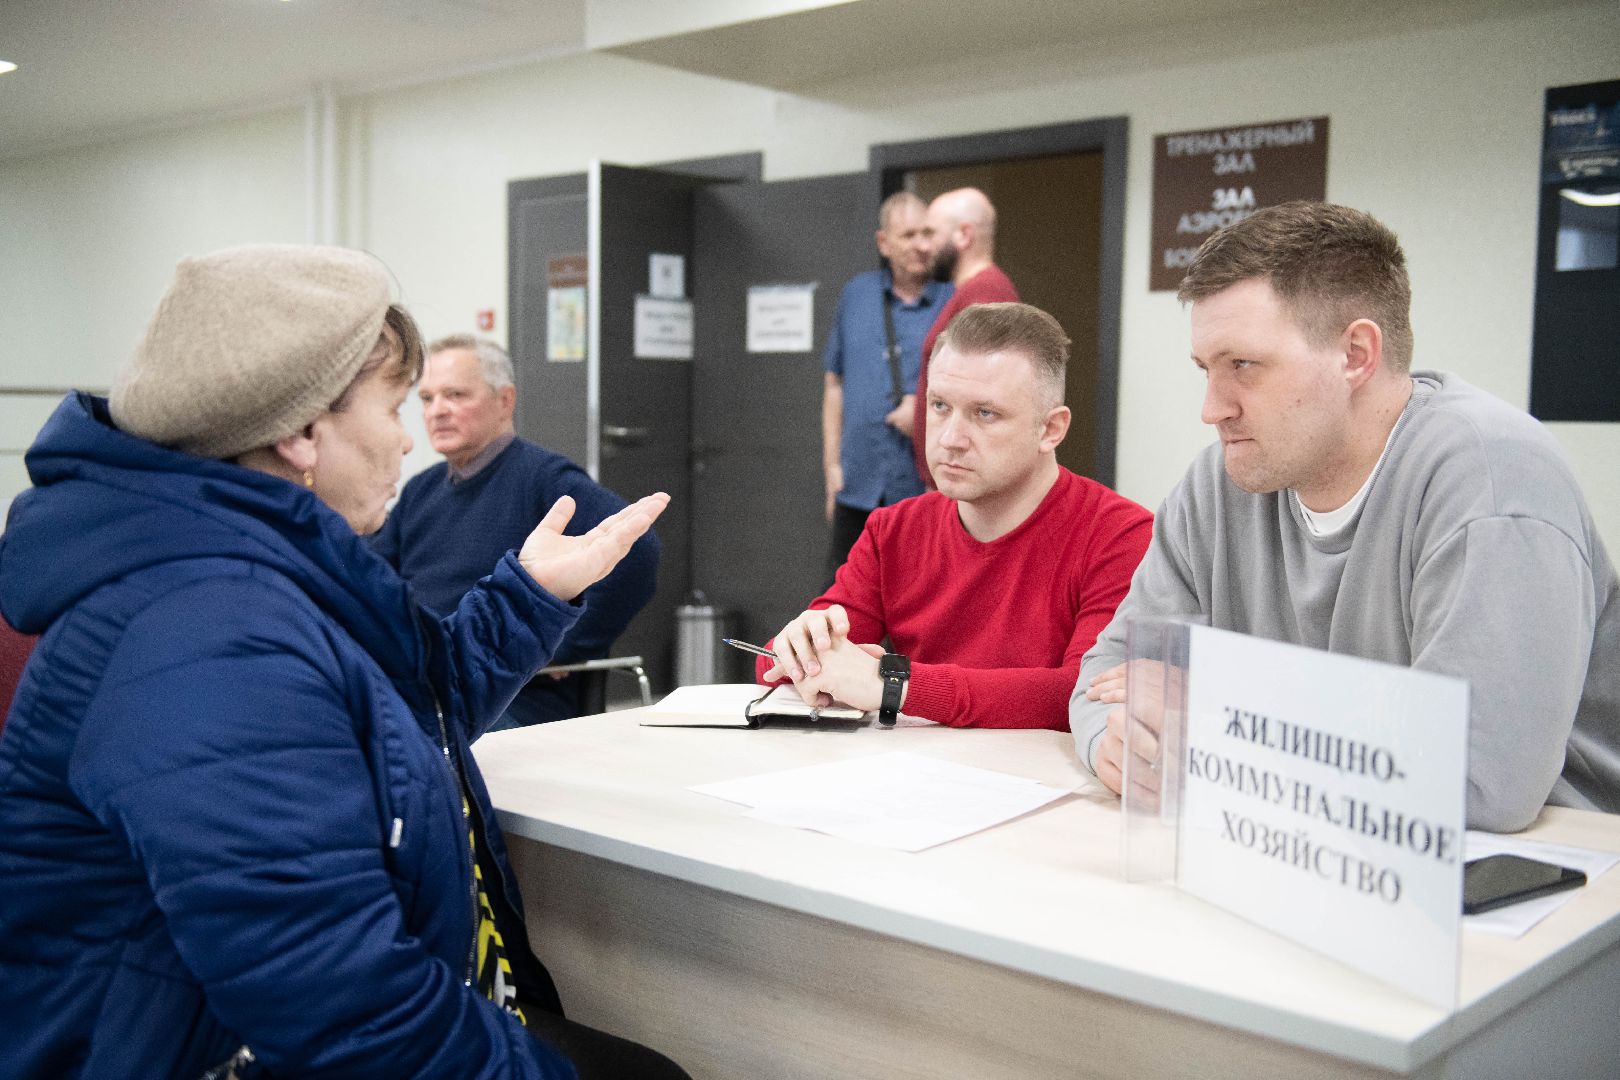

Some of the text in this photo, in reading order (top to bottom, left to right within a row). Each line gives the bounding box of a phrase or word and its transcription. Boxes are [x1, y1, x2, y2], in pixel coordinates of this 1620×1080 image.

[1212, 153, 1255, 175] ЗАЛ
[1176, 209, 1250, 233] АЭРО
[1212, 186, 1255, 210] ЗАЛ
[1224, 705, 1406, 784] ЖИЛИЩНО-
[1189, 746, 1457, 864] КОММУНАЛЬНОЕ
[1221, 809, 1402, 904] ХОЗЯЙСТВО
